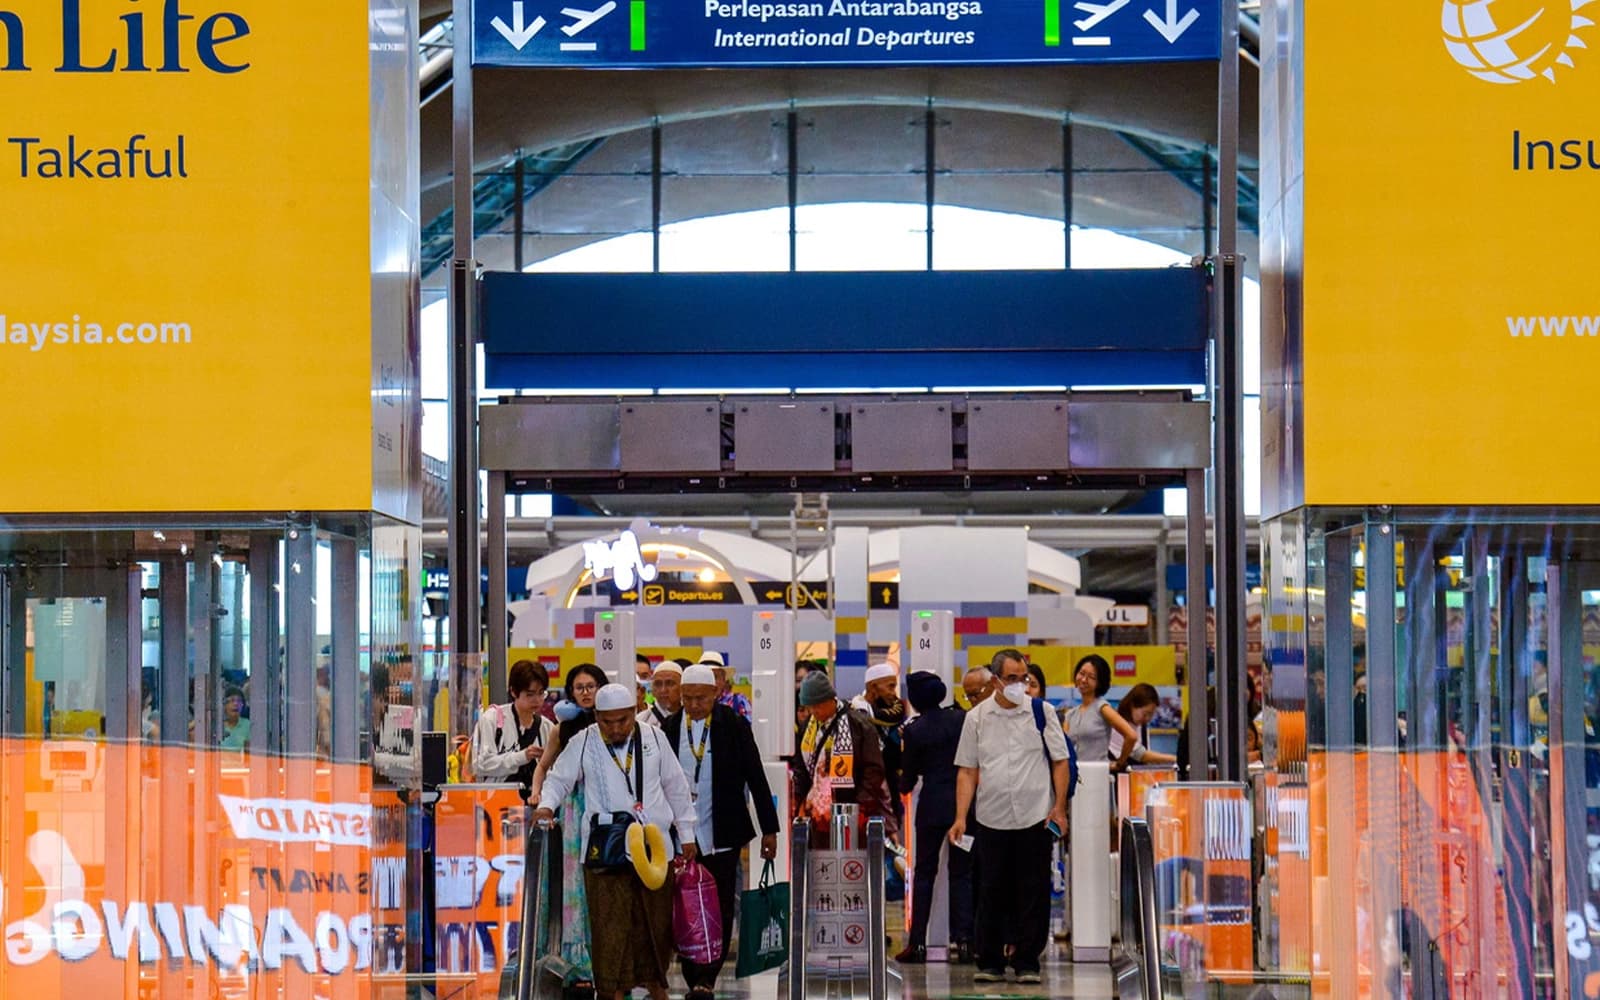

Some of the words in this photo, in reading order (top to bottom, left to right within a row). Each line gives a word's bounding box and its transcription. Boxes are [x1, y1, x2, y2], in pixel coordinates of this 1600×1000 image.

[705, 0, 824, 22] Perlepasan
[828, 0, 983, 20] Antarabangsa
[54, 0, 250, 74] Life
[714, 28, 851, 47] International
[857, 27, 975, 50] Departures
[8, 135, 188, 178] Takaful
[0, 314, 192, 351] laysia.com
[602, 638, 614, 650] 06
[760, 638, 772, 650] 05
[919, 638, 930, 650] 04
